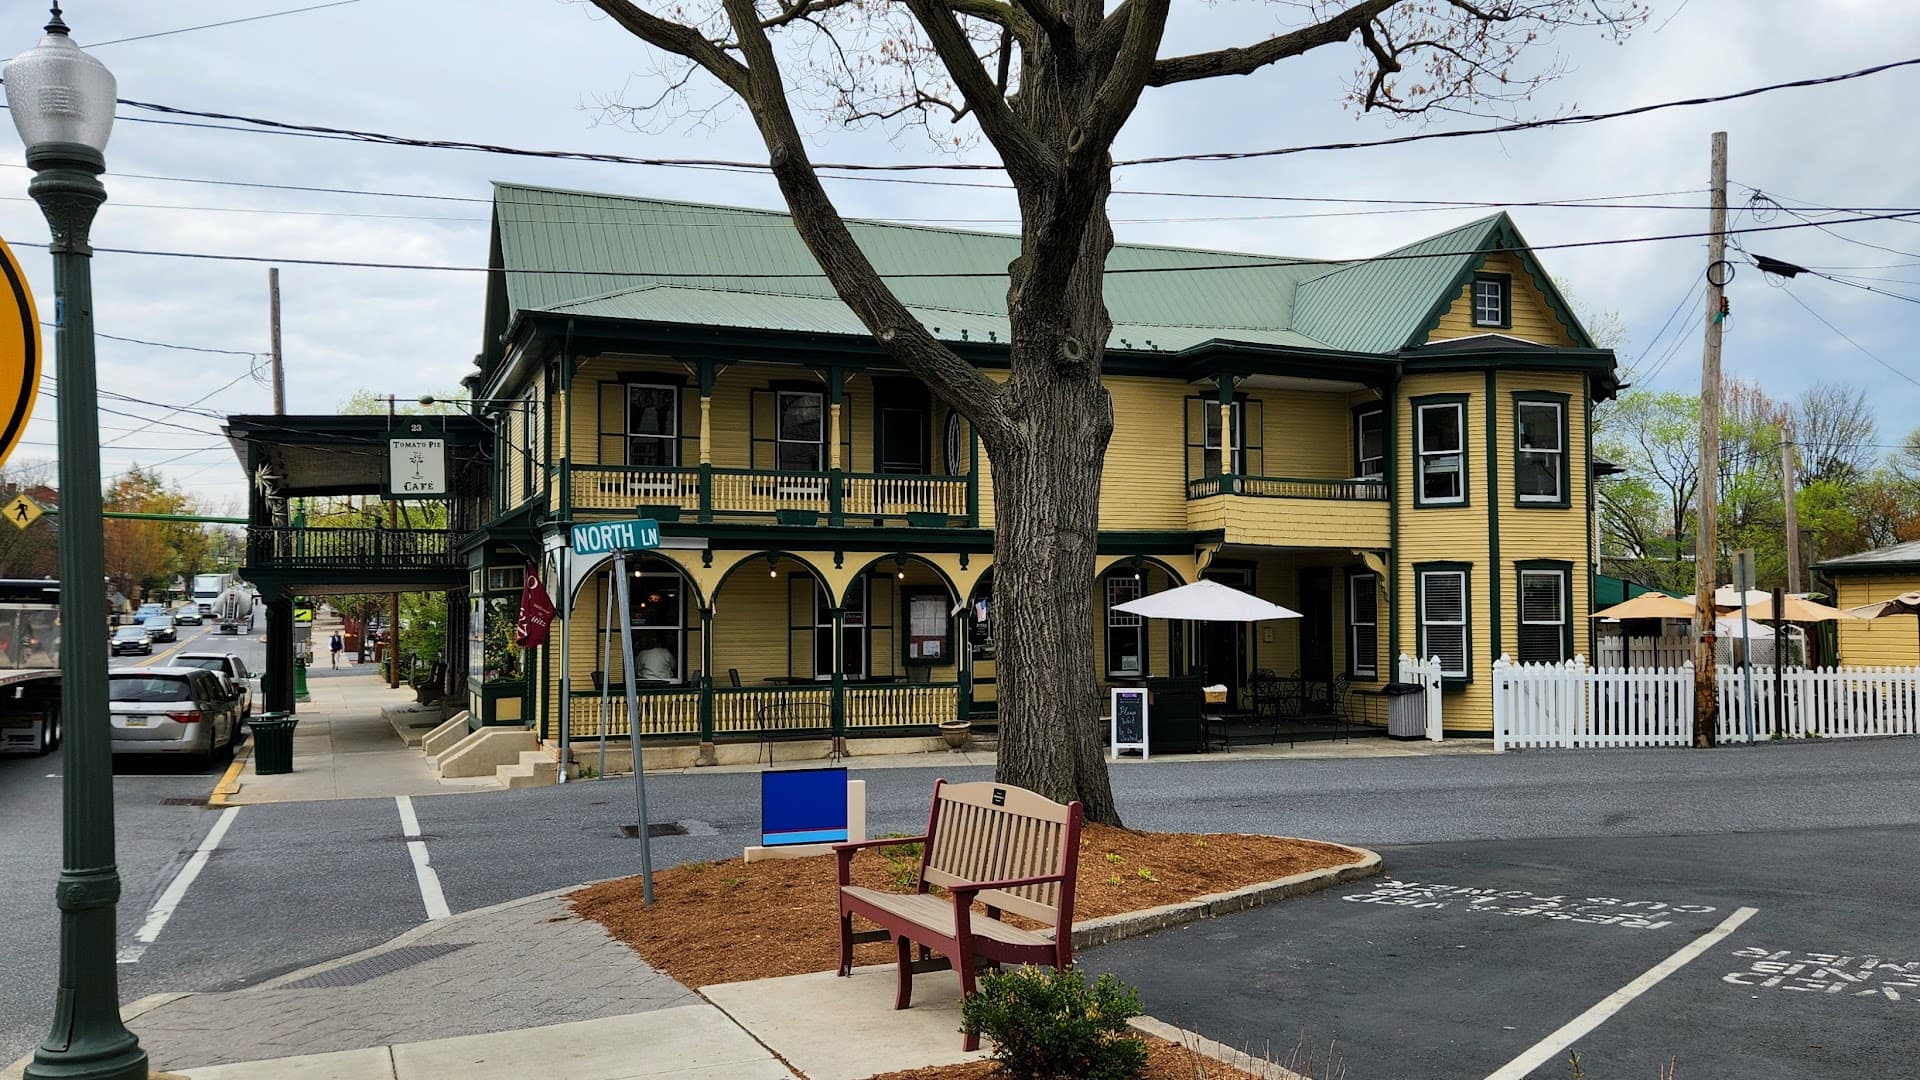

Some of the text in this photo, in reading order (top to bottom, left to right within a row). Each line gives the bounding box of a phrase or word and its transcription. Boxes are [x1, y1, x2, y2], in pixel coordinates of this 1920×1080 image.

[411, 424, 422, 432] 23
[573, 523, 658, 553] NORTH LN
